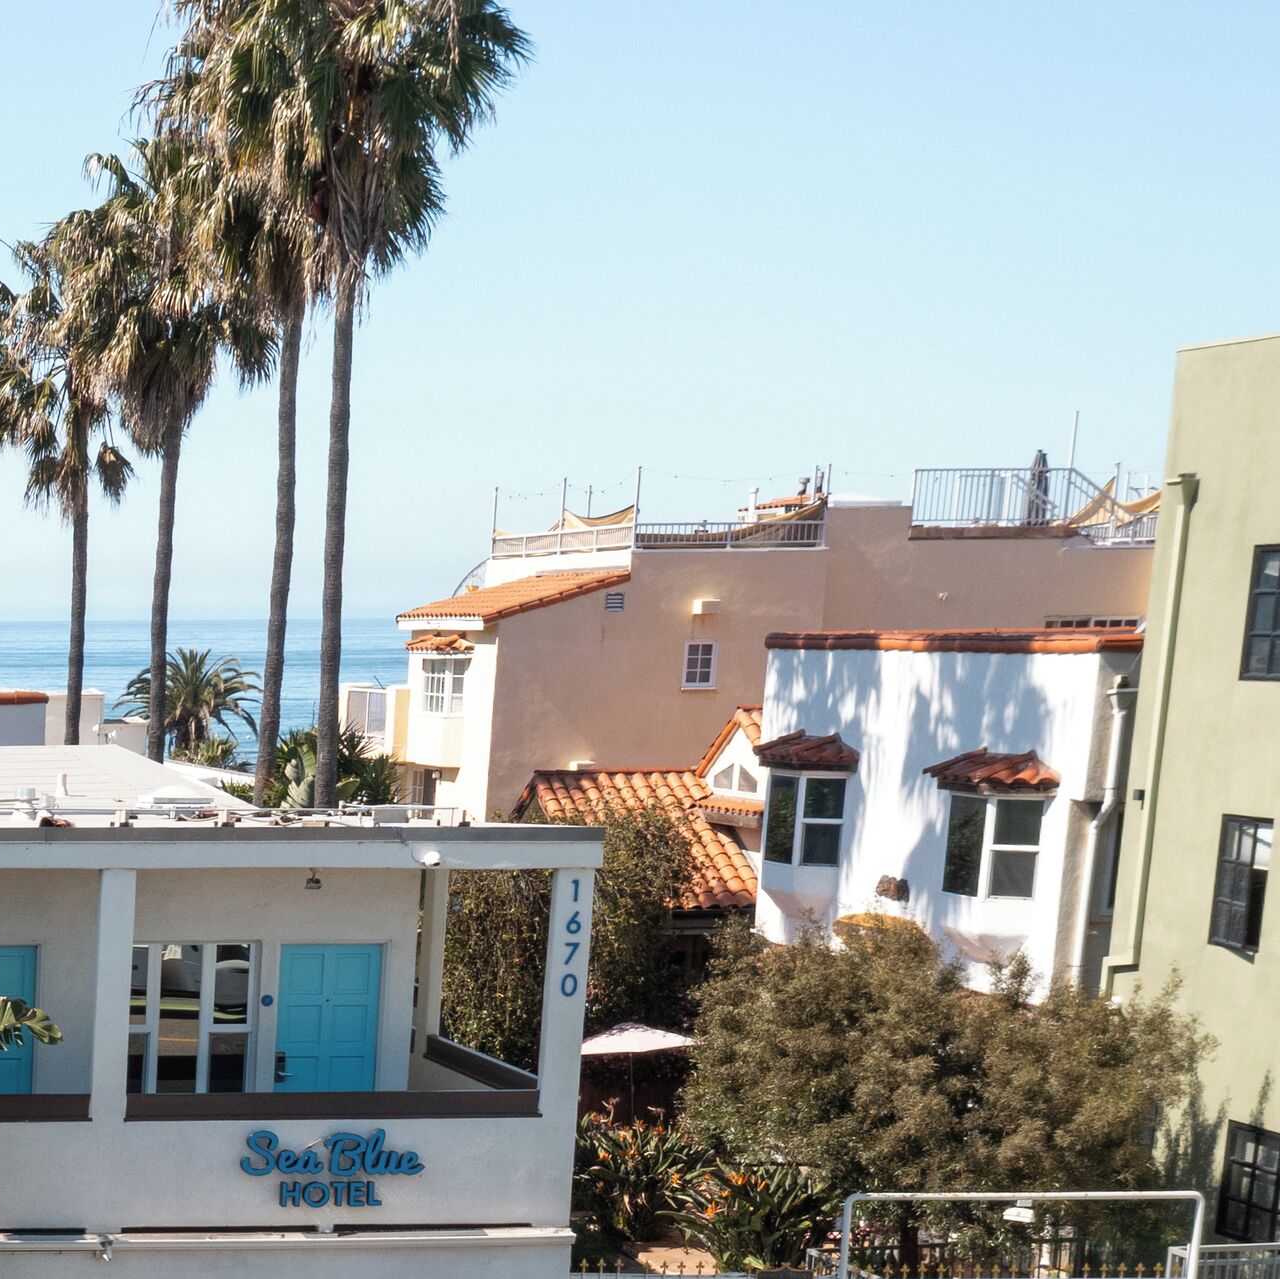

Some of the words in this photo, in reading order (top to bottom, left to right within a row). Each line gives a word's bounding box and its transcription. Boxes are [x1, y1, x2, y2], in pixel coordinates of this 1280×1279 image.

[560, 878, 582, 997] 1670
[240, 1129, 324, 1176] Sea
[324, 1128, 425, 1177] Blue
[279, 1180, 383, 1208] HOTEL
